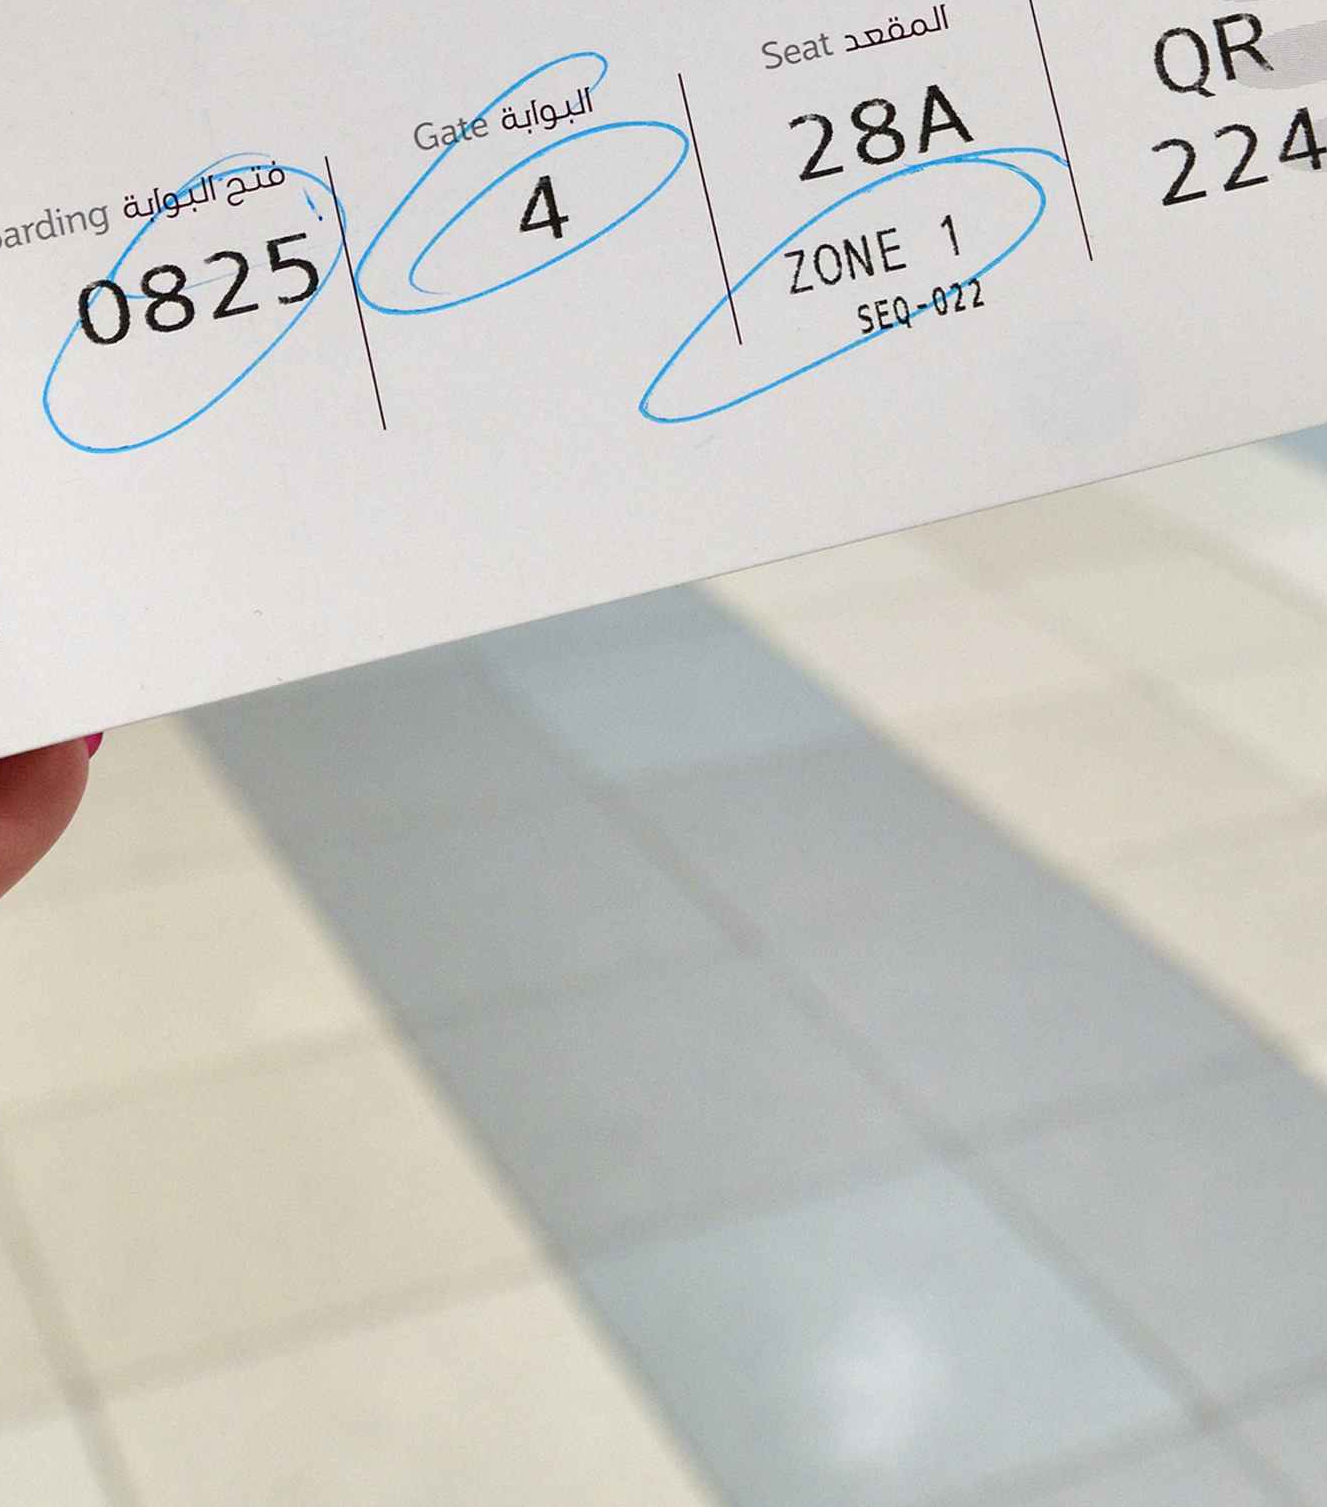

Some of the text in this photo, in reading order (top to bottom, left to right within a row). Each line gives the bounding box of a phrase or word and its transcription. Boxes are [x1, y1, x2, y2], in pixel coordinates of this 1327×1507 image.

[760, 31, 834, 71] Seat
[844, 4, 950, 55] المقعد
[1154, 11, 1275, 98] QR
[412, 111, 490, 153] Gate
[500, 86, 595, 136] البوابة
[787, 83, 975, 183] 28A
[122, 159, 287, 222] فتح البوابة
[517, 174, 570, 240] 4
[783, 214, 962, 296] ZONE 1
[76, 231, 321, 346] 0825
[856, 277, 986, 336] SEQ-022
